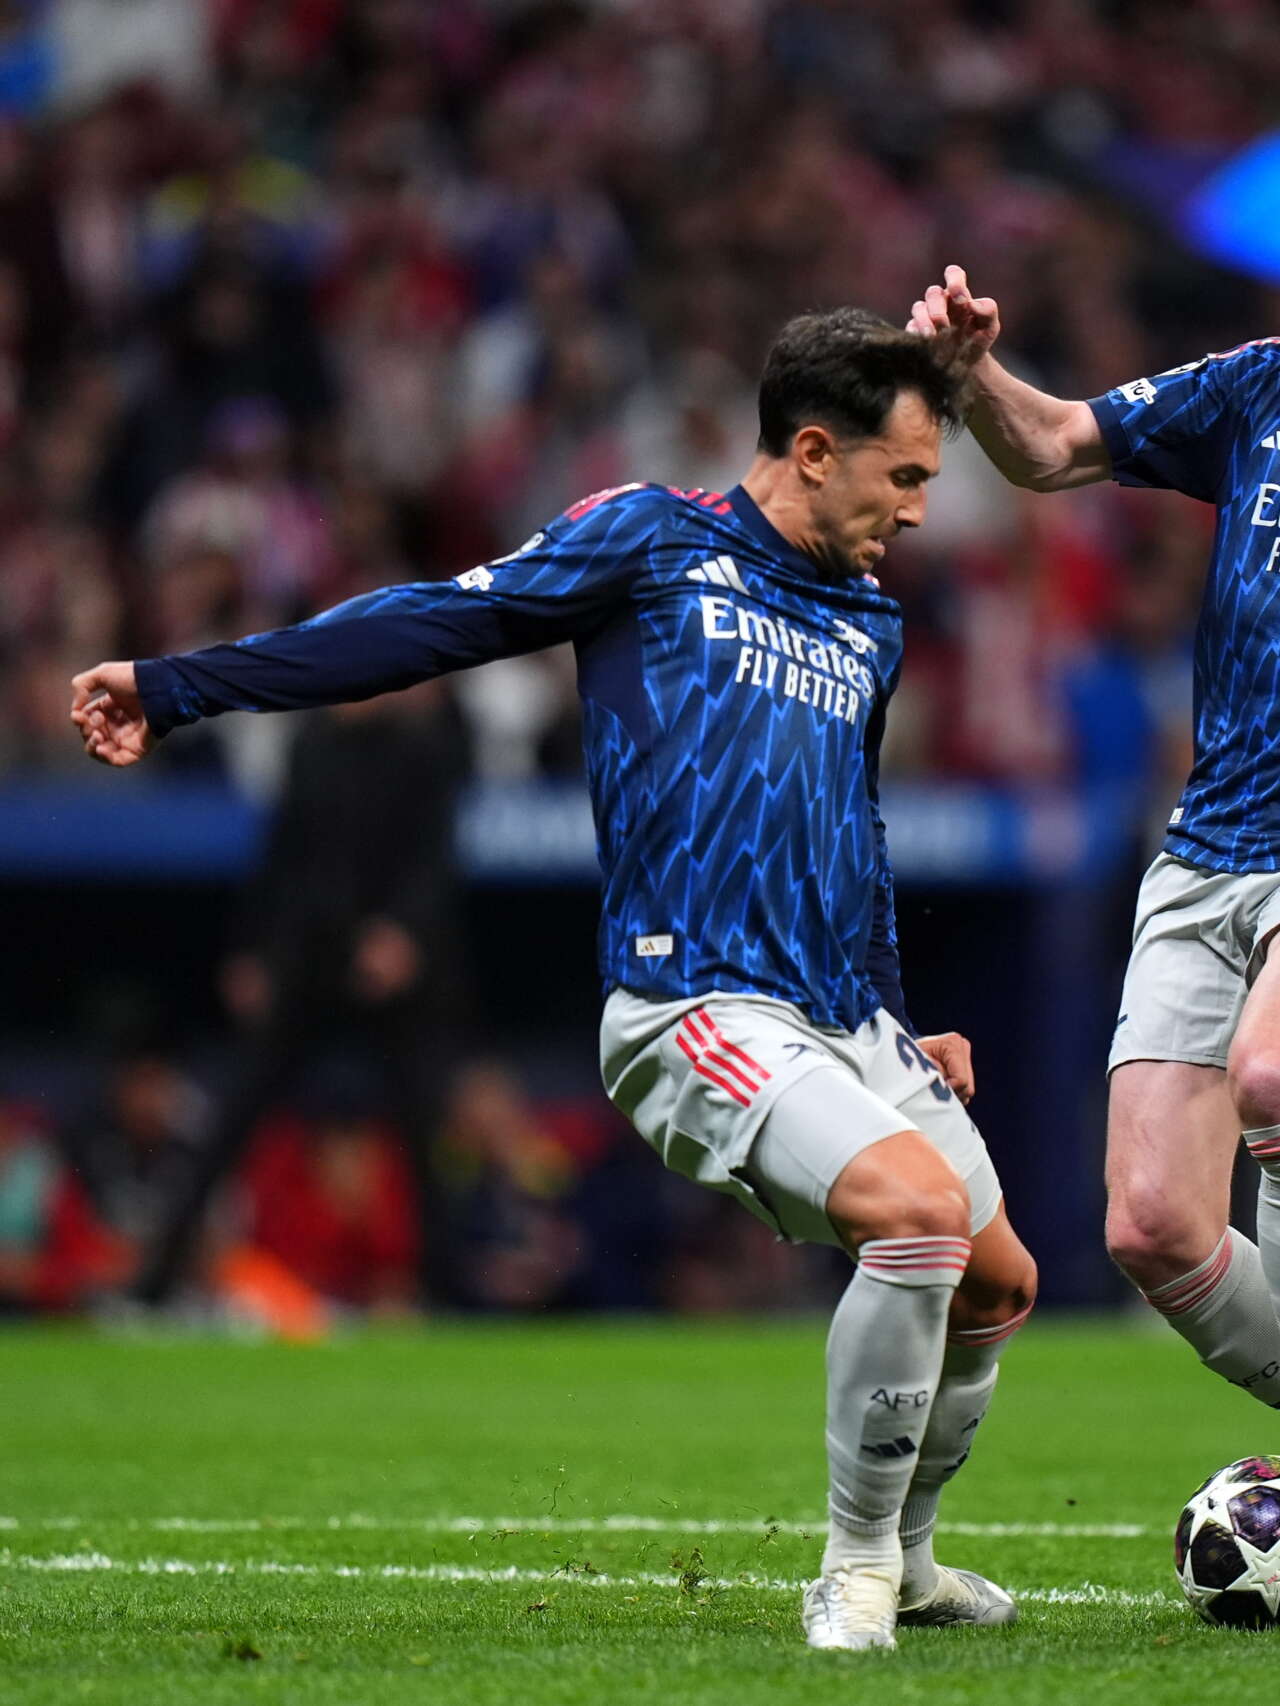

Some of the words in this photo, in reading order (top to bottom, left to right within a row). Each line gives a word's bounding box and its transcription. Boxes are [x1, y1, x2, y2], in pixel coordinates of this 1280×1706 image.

[698, 596, 875, 699] Emirates
[735, 646, 779, 690] FLY
[784, 662, 860, 726] BETTER
[870, 1388, 929, 1411] AFC
